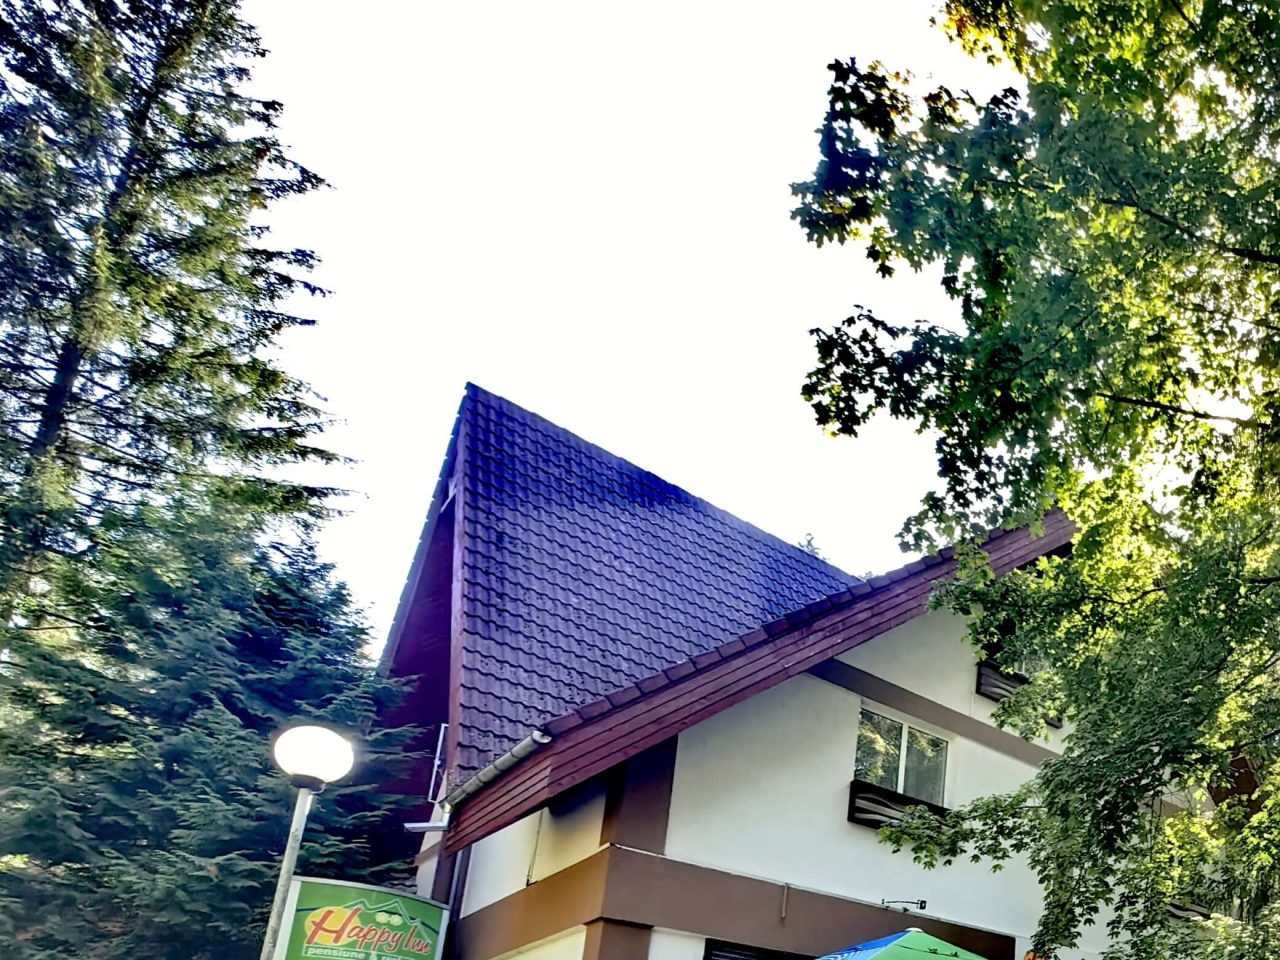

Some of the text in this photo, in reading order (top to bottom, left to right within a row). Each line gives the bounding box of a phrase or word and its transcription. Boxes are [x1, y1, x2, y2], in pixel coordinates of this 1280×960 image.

[306, 907, 430, 955] Happy Inn
[307, 947, 365, 960] pensiune
